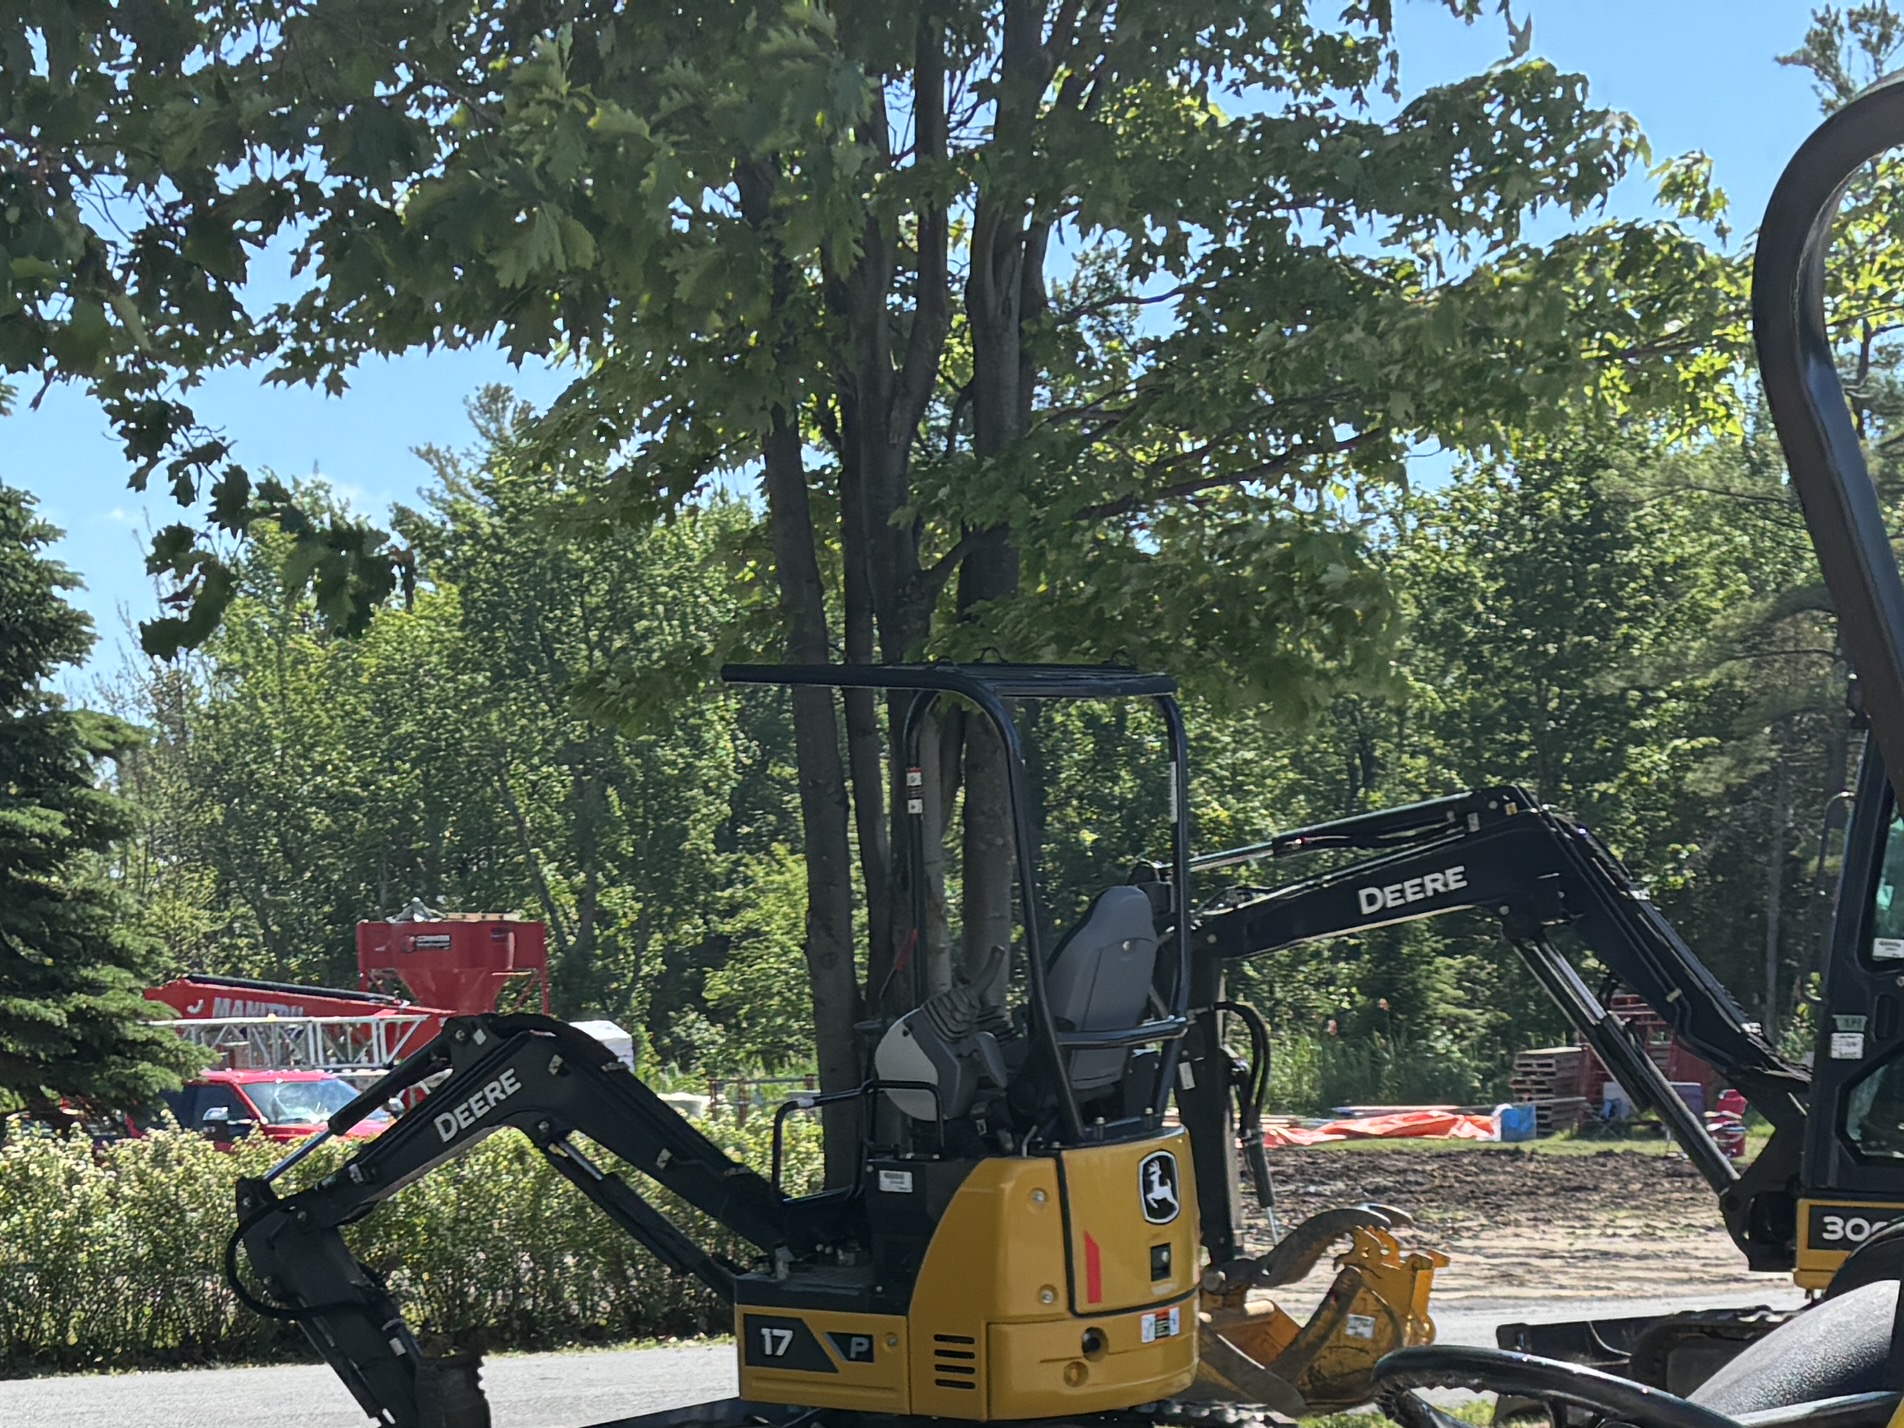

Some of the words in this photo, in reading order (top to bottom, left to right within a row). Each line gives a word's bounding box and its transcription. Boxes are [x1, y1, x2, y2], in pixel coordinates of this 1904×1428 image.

[1358, 865, 1468, 915] DEERE
[433, 1067, 522, 1143] DEERE
[761, 1327, 794, 1357] 17
[849, 1336, 870, 1360] P
